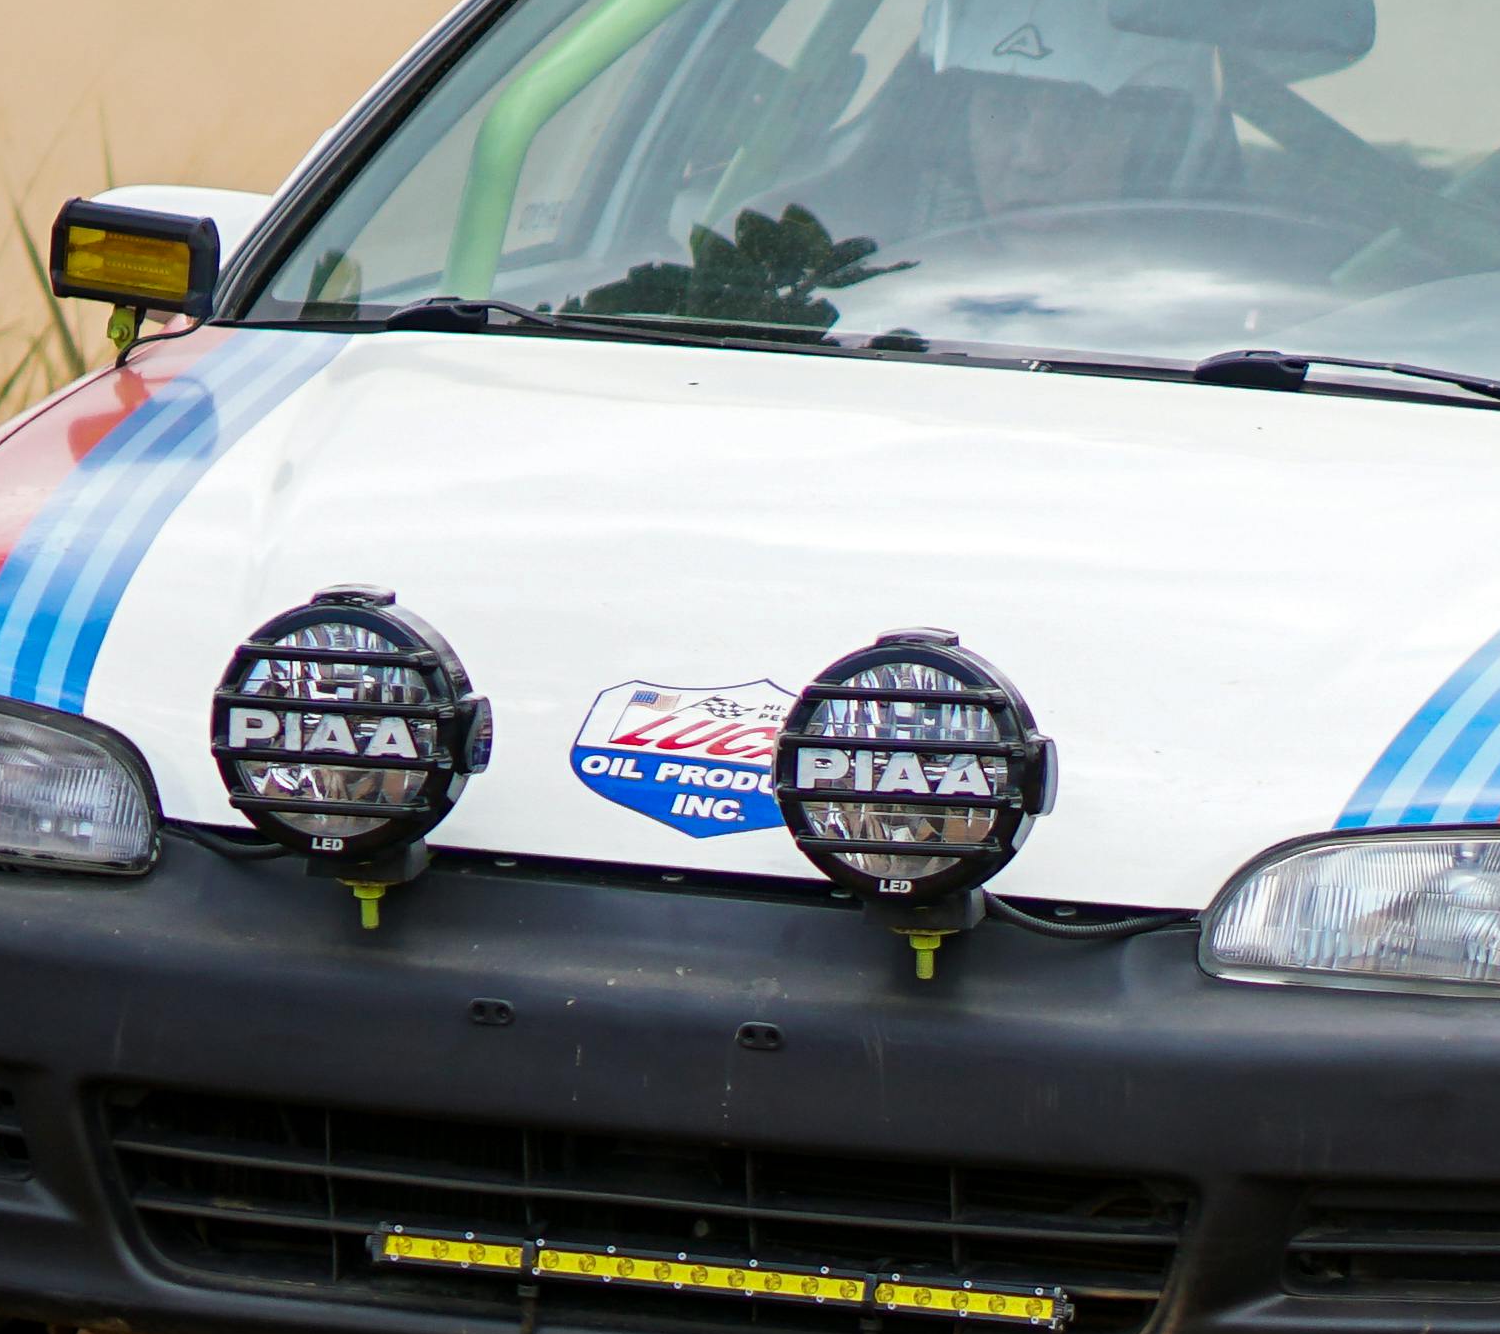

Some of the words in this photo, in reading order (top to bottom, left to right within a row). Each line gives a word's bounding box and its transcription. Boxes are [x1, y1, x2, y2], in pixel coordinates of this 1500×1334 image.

[229, 707, 419, 759] PIAA
[581, 755, 643, 779] OIL
[654, 762, 775, 795] PRODU
[796, 747, 992, 796] PIAA
[670, 793, 746, 821] INC.
[311, 837, 344, 851] LED
[878, 879, 912, 894] LED
